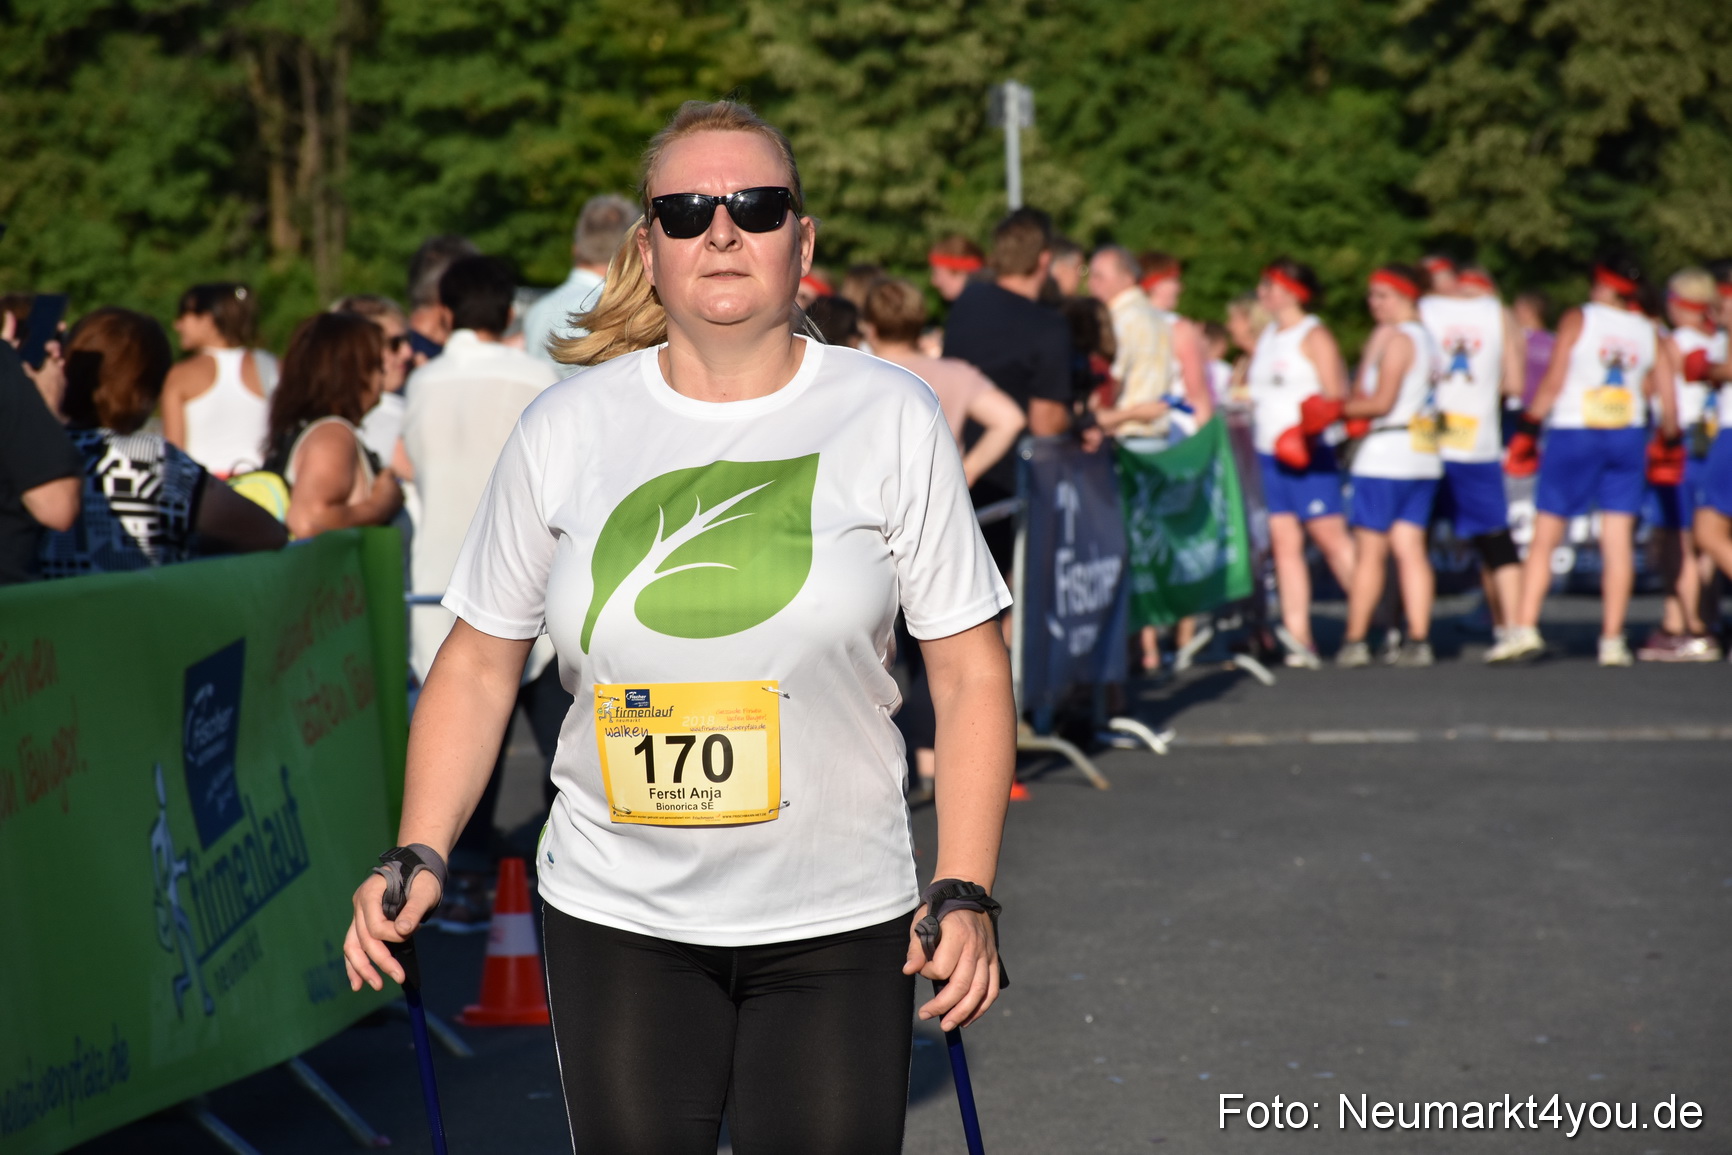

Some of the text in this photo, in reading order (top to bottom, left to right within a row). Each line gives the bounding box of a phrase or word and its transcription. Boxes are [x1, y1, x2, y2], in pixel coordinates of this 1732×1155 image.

[615, 705, 675, 718] firmenlauf
[682, 715, 715, 727] 2018
[605, 725, 649, 738] walken
[634, 733, 734, 784] 170
[649, 787, 722, 801] Ferstl Anja
[656, 801, 714, 811] Bionorica SE
